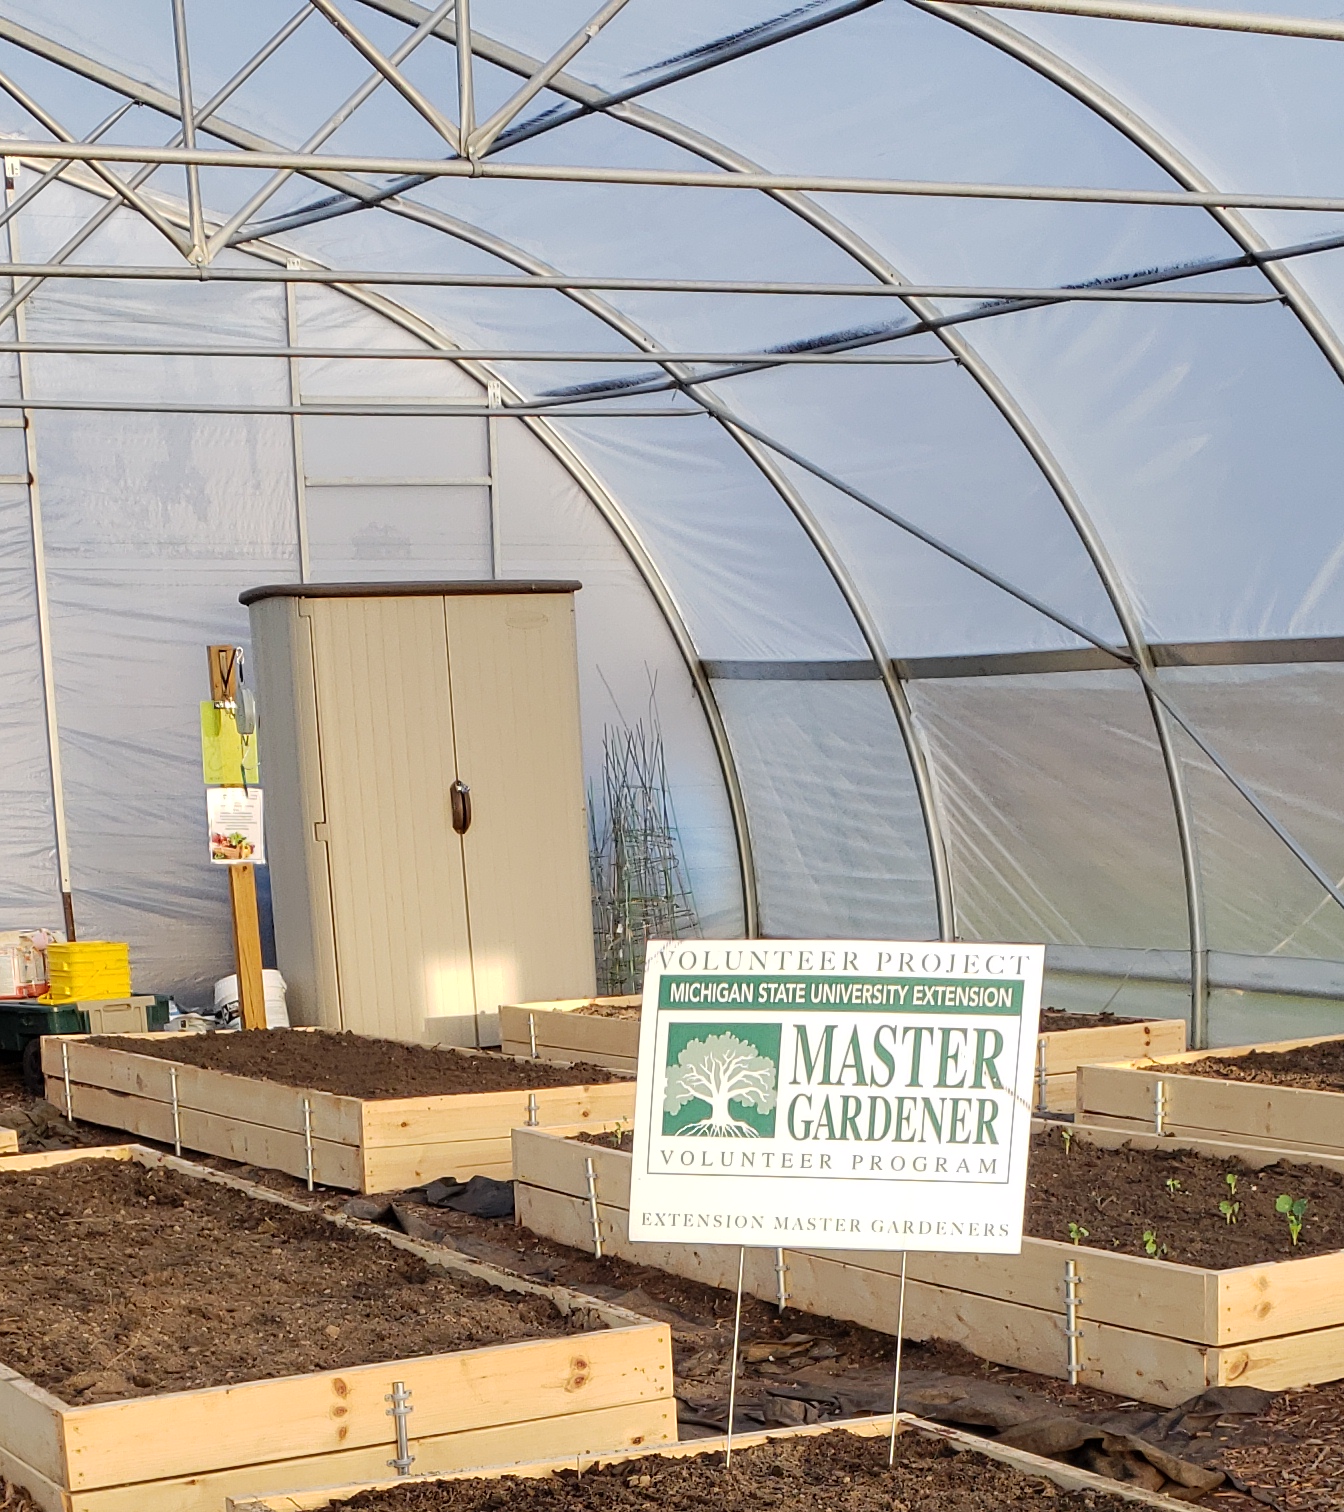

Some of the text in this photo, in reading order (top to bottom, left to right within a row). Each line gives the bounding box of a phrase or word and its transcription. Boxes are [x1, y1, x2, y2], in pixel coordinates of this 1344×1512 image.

[659, 950, 1030, 976] VOLUNTEER PROJECT
[670, 982, 1013, 1008] MICHIGAN STATE UNIVERSITY EXTENSION
[788, 1024, 1004, 1089] MASTER
[787, 1093, 999, 1145] GARDENER
[661, 1150, 997, 1174] VOLUNTEER PROGRAM
[641, 1212, 1009, 1237] EXTENSION MASTER GARDENERS
